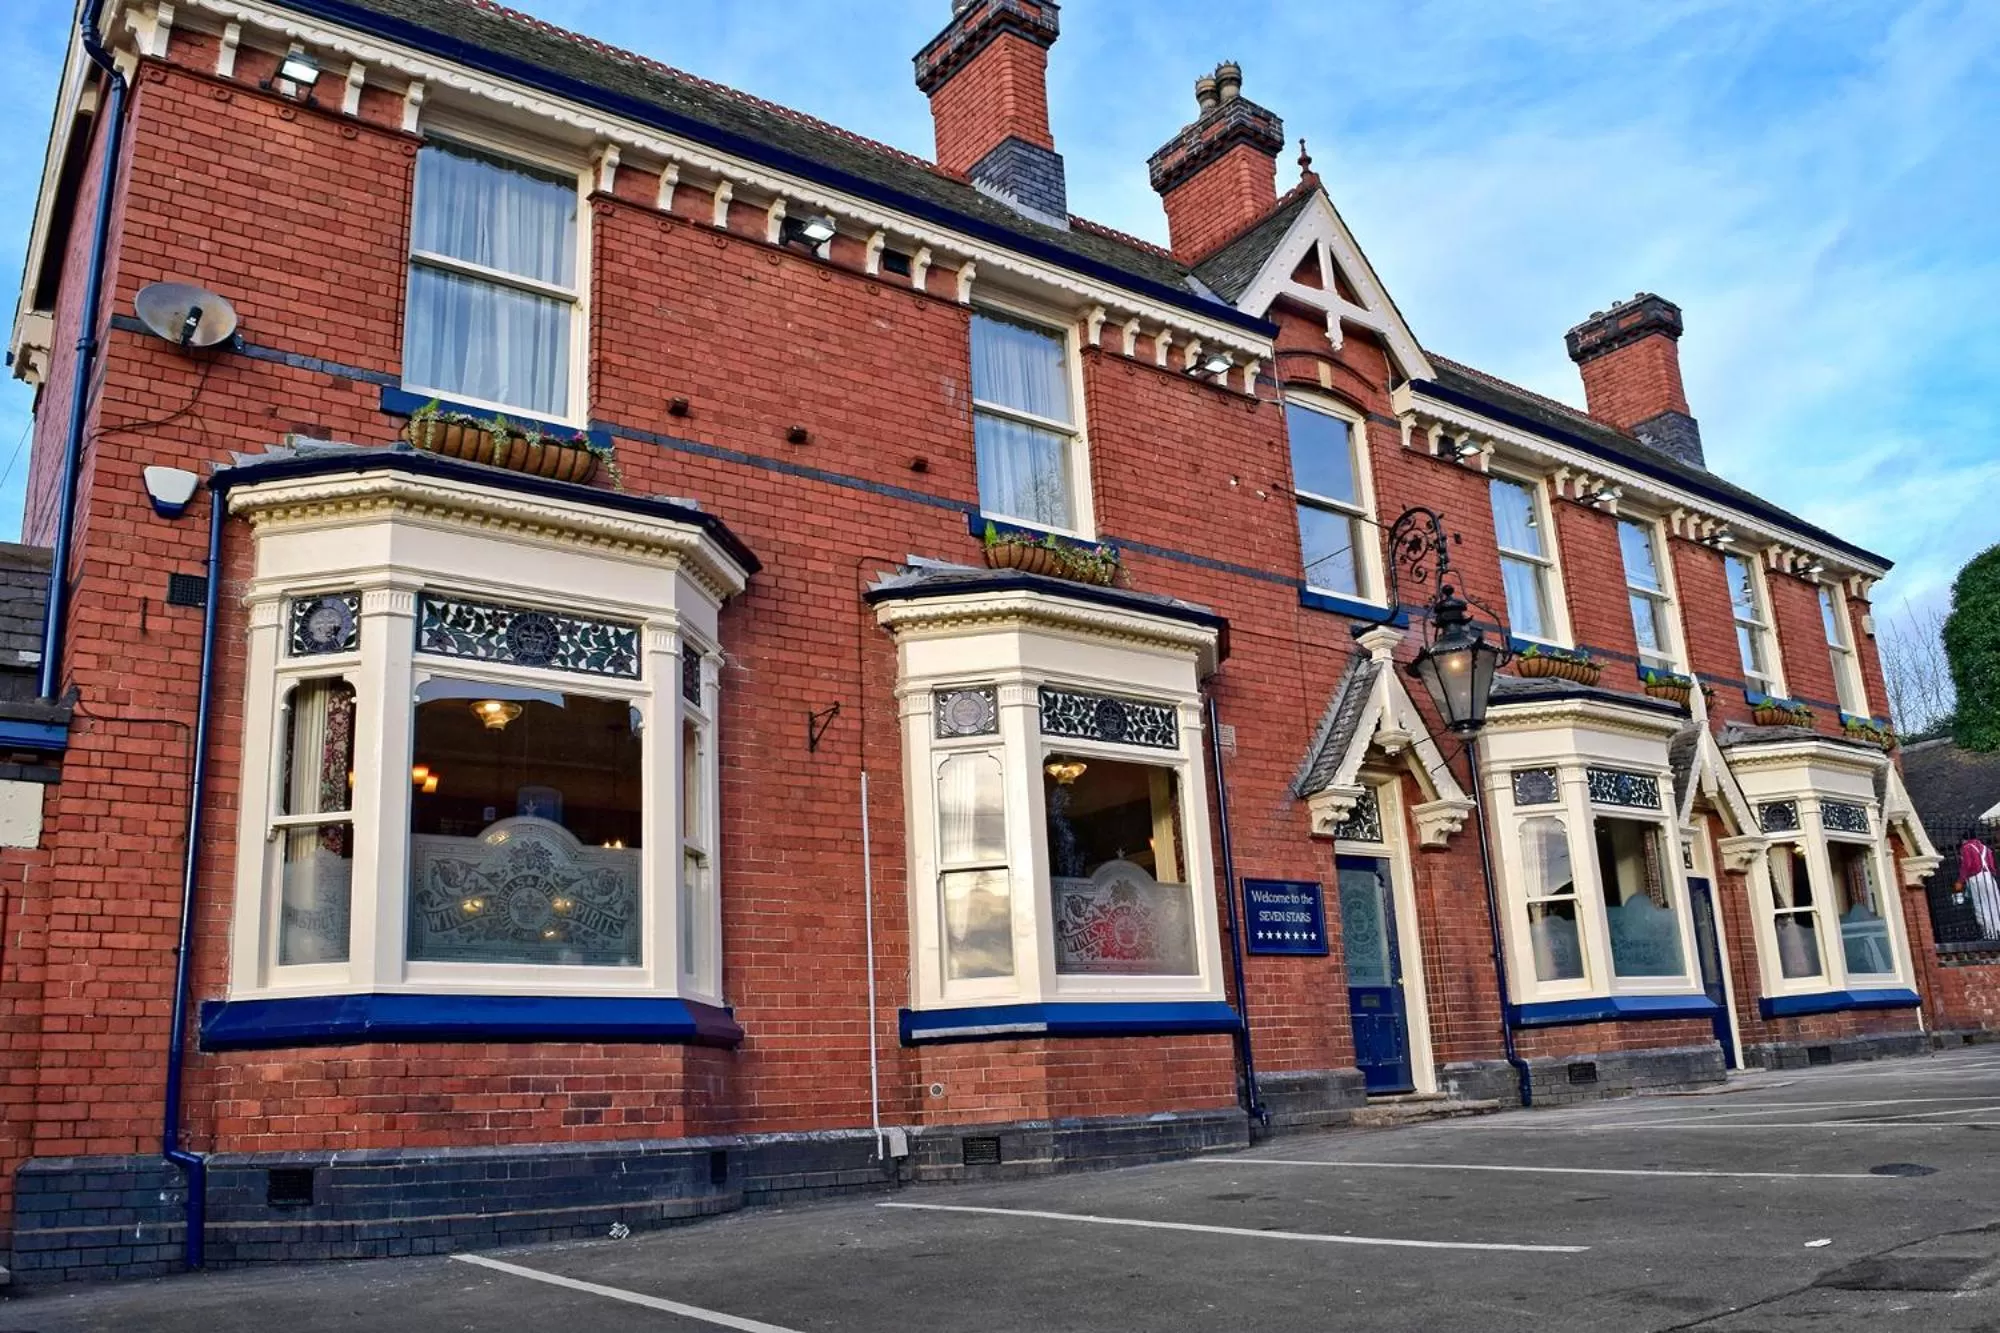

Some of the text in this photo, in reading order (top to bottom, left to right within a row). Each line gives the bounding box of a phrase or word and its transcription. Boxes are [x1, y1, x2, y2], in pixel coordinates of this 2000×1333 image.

[1251, 890, 1314, 905] Welcome to the
[1259, 910, 1312, 923] SEVEN STARS
[1066, 924, 1099, 953] WINES
